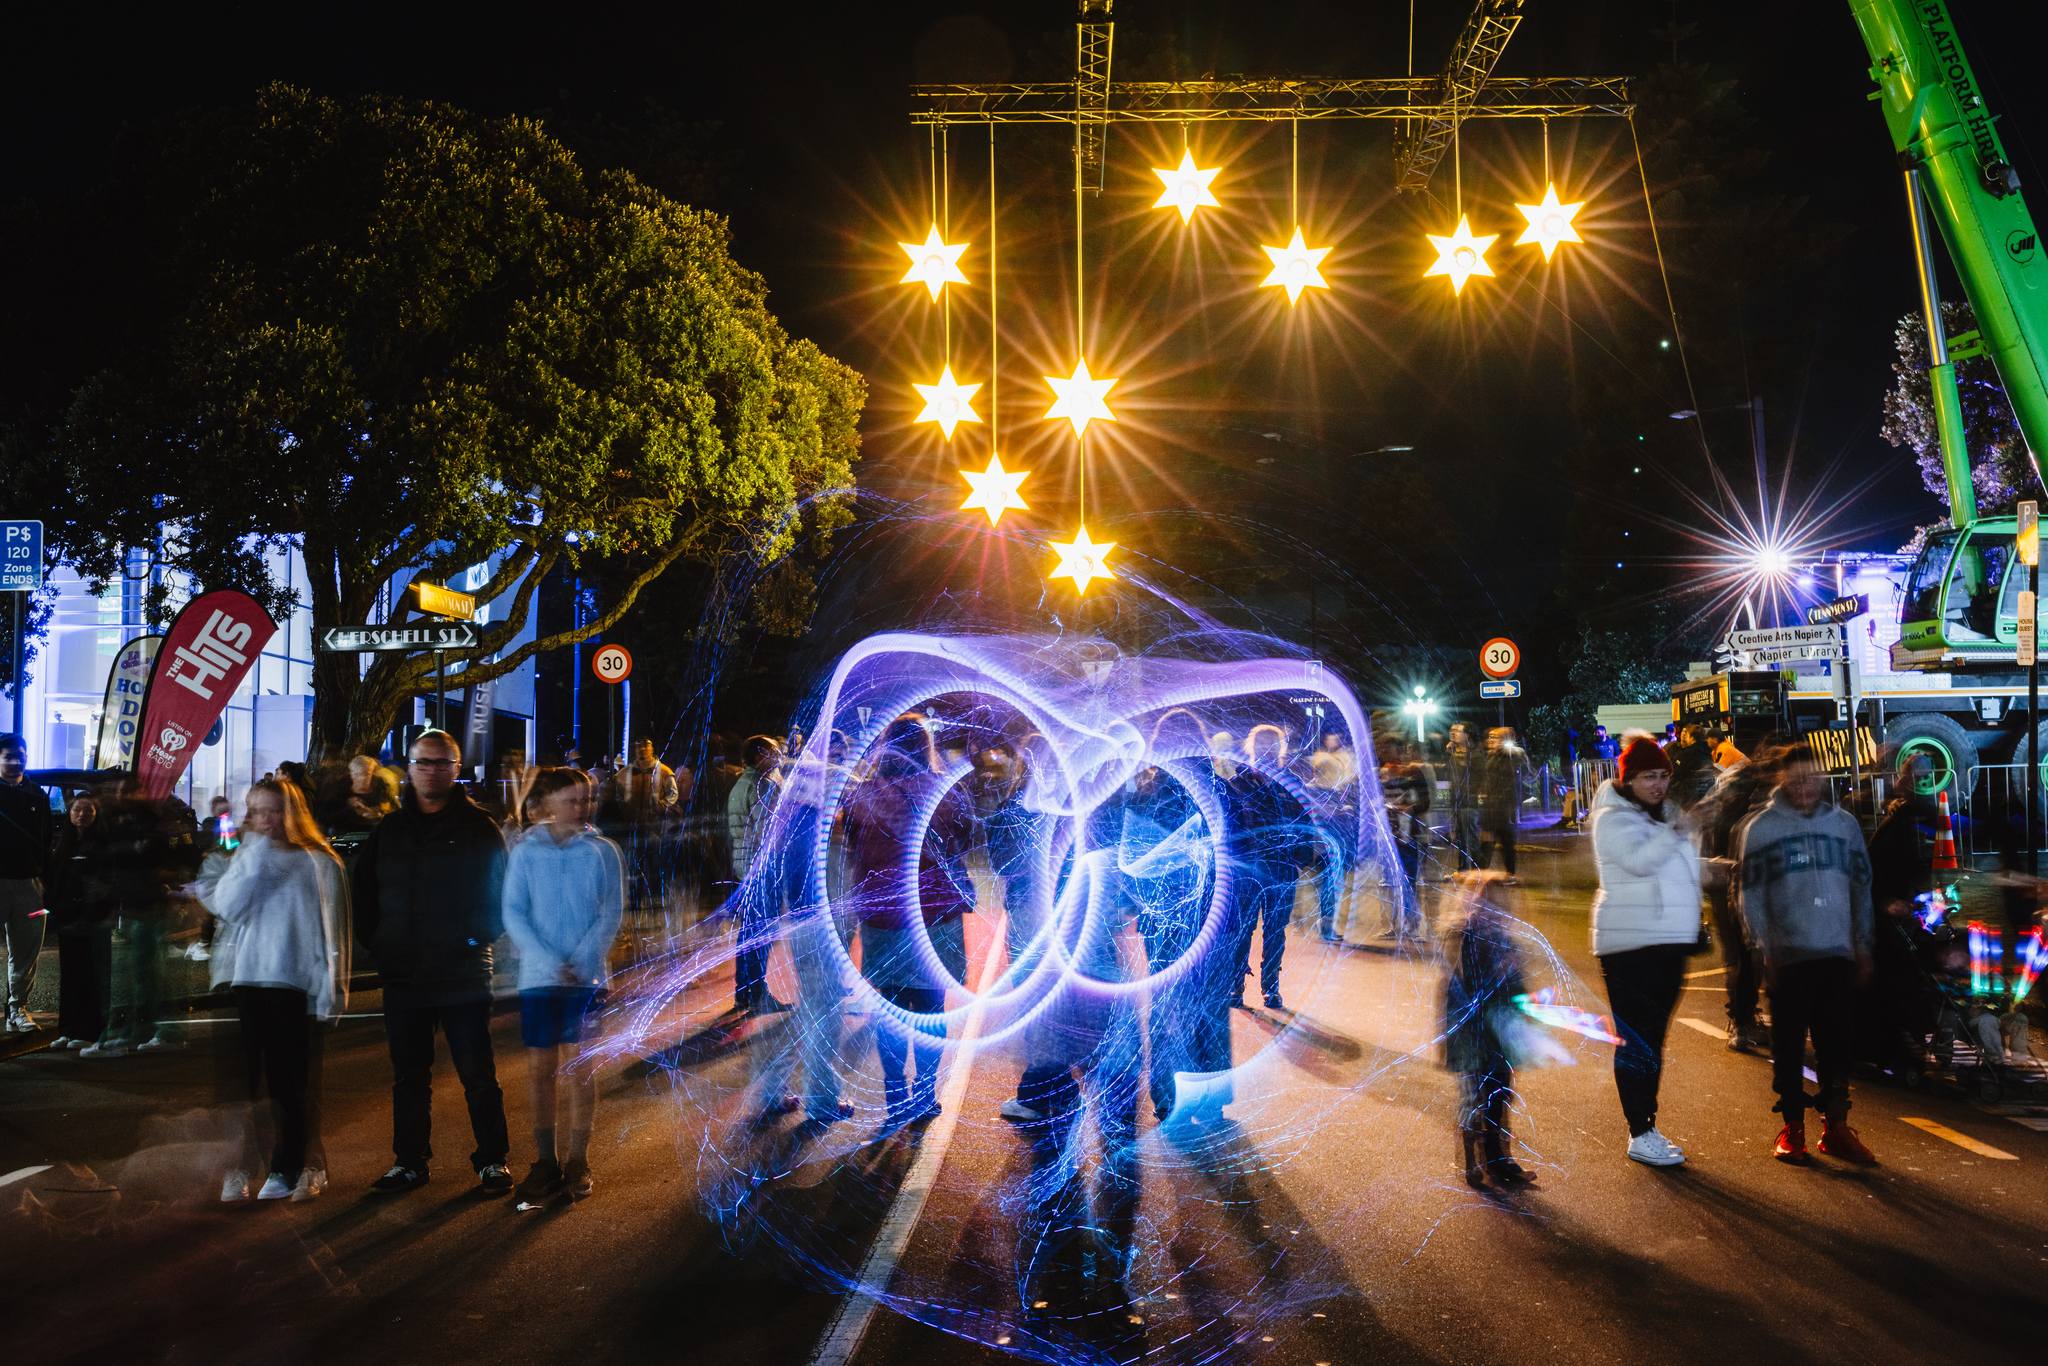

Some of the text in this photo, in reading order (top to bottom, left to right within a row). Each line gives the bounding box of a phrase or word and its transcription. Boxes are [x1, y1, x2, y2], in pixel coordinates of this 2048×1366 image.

[1924, 4, 1979, 114] PLATFORM
[6, 526, 31, 542] P$
[8, 546, 30, 559] 120
[4, 563, 32, 573] Zone
[2, 575, 33, 584] ENDS
[337, 628, 459, 646] HERSCHELL ST
[1738, 630, 1823, 645] Creative Arts Napier
[175, 608, 252, 700] HITS
[1490, 650, 1510, 664] 30
[1760, 650, 1792, 662] Napier
[165, 657, 185, 678] THE
[602, 657, 622, 670] 30
[472, 656, 491, 733] MUSE
[167, 720, 193, 738] LISTEN ON
[146, 750, 173, 769] RADIO
[150, 744, 177, 763] iHeart
